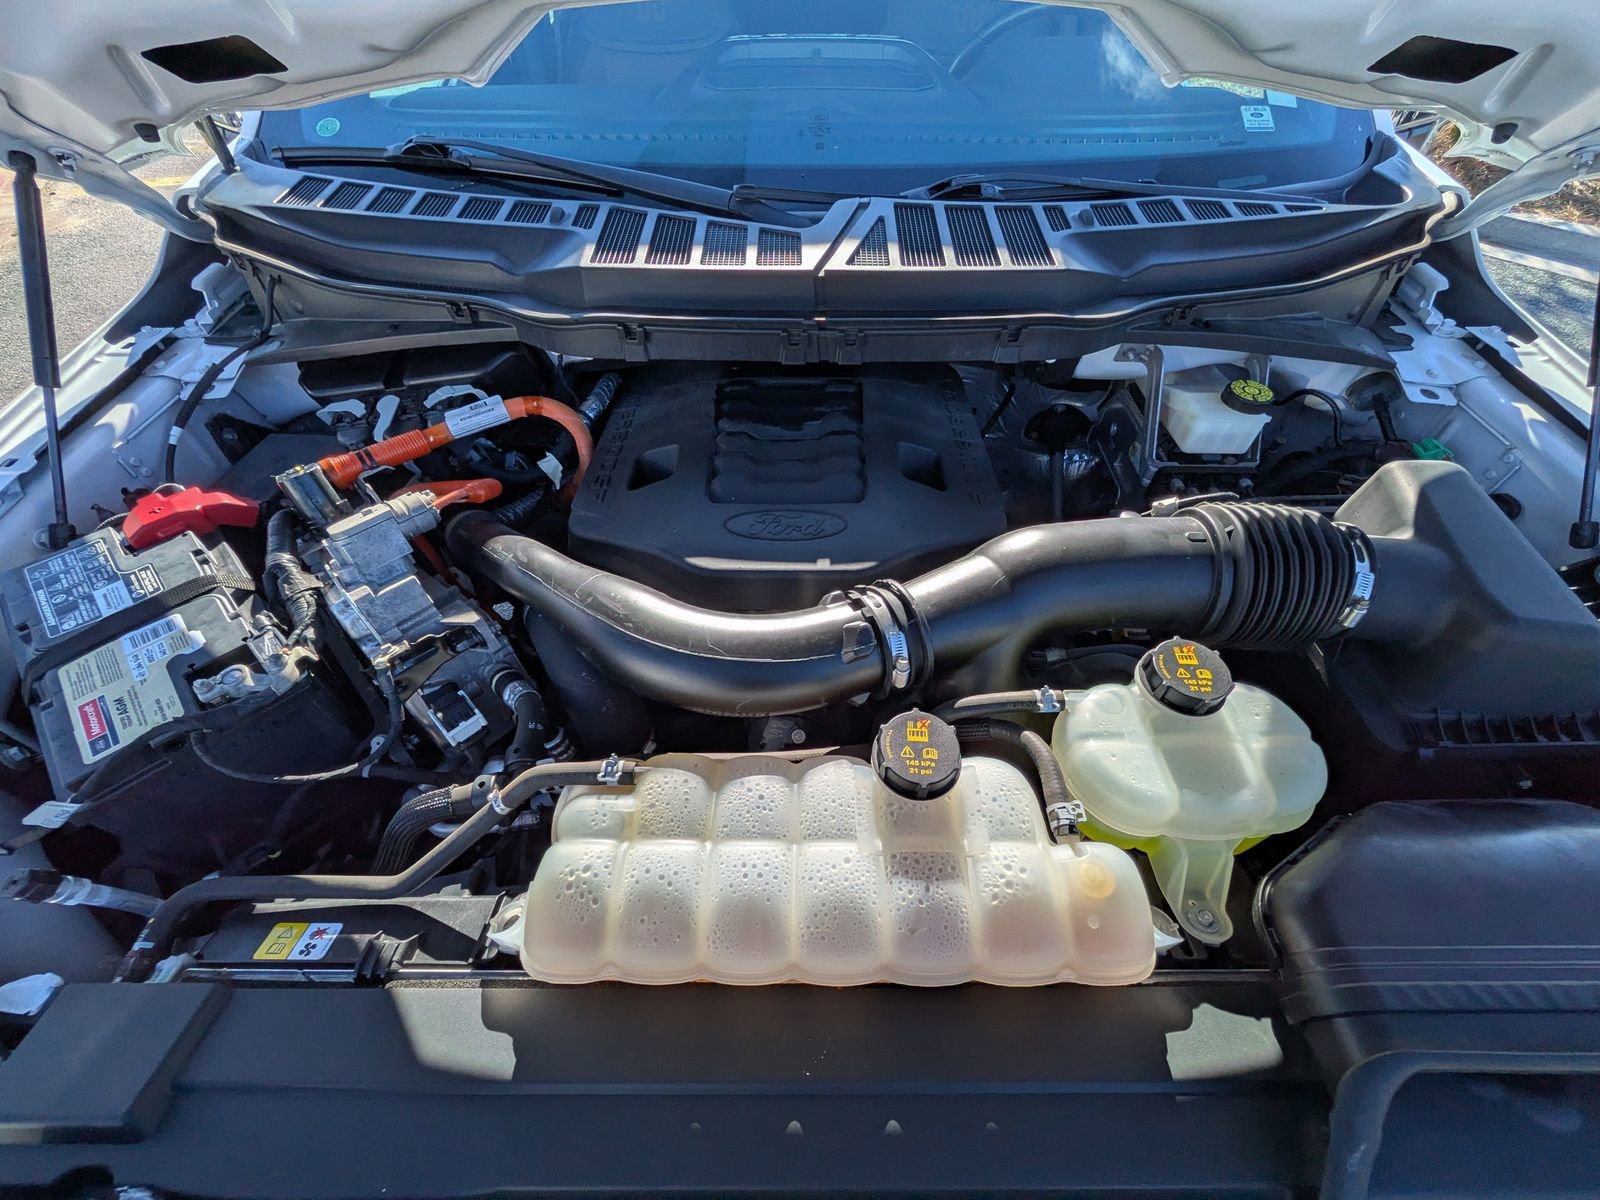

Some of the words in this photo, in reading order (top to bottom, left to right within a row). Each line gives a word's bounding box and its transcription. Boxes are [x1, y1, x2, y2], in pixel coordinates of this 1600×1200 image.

[744, 511, 828, 538] Ford
[83, 704, 101, 736] Motorcraft
[113, 696, 129, 717] AGM
